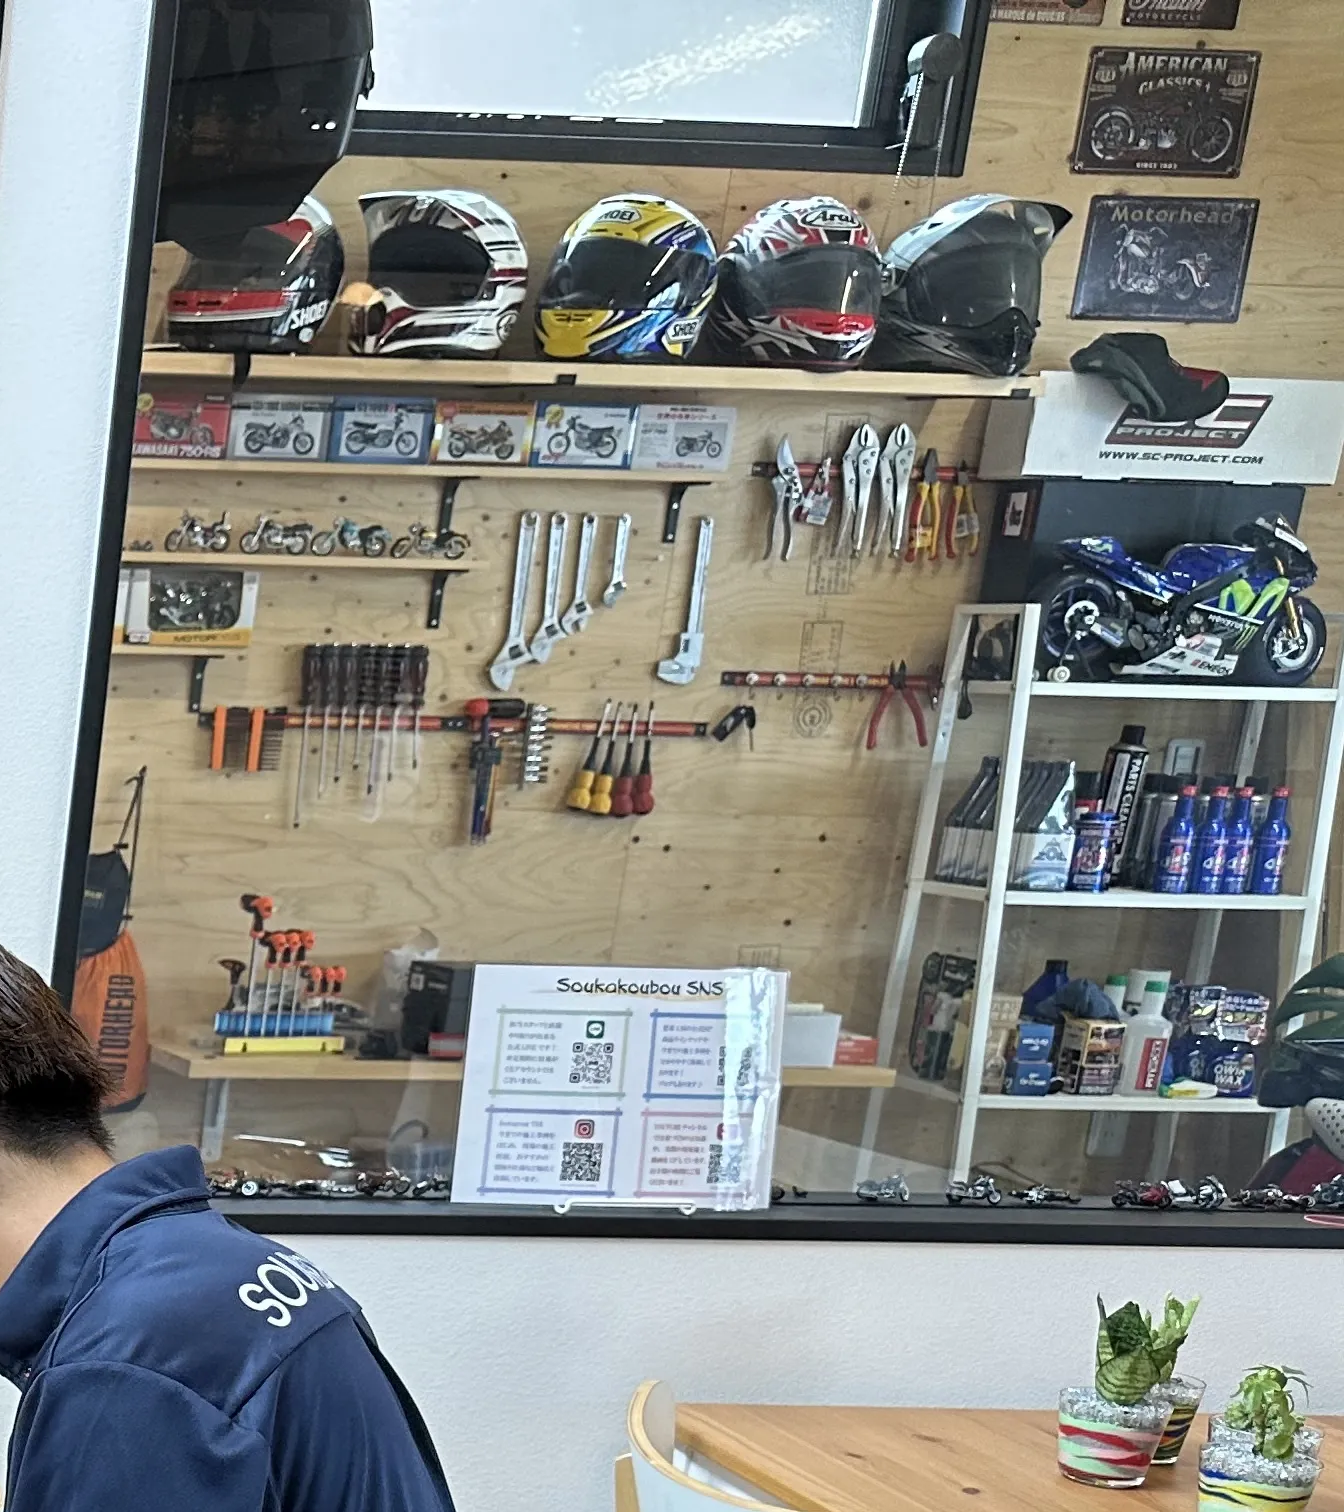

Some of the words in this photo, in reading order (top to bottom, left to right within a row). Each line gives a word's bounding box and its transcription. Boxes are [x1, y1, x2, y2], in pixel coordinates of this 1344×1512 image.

[1120, 51, 1228, 79] AMERICAN
[808, 209, 857, 226] Arai
[1111, 204, 1235, 224] Motorhead
[1116, 426, 1246, 440] PROJECT
[1098, 450, 1264, 465] WWW.SC-PROJECT.COM
[1198, 662, 1232, 676] ENEOS
[1124, 758, 1143, 792] PARTS
[556, 976, 682, 997] Soukakoubou
[685, 981, 725, 997] SNS
[98, 973, 135, 1079] OTORHEAD
